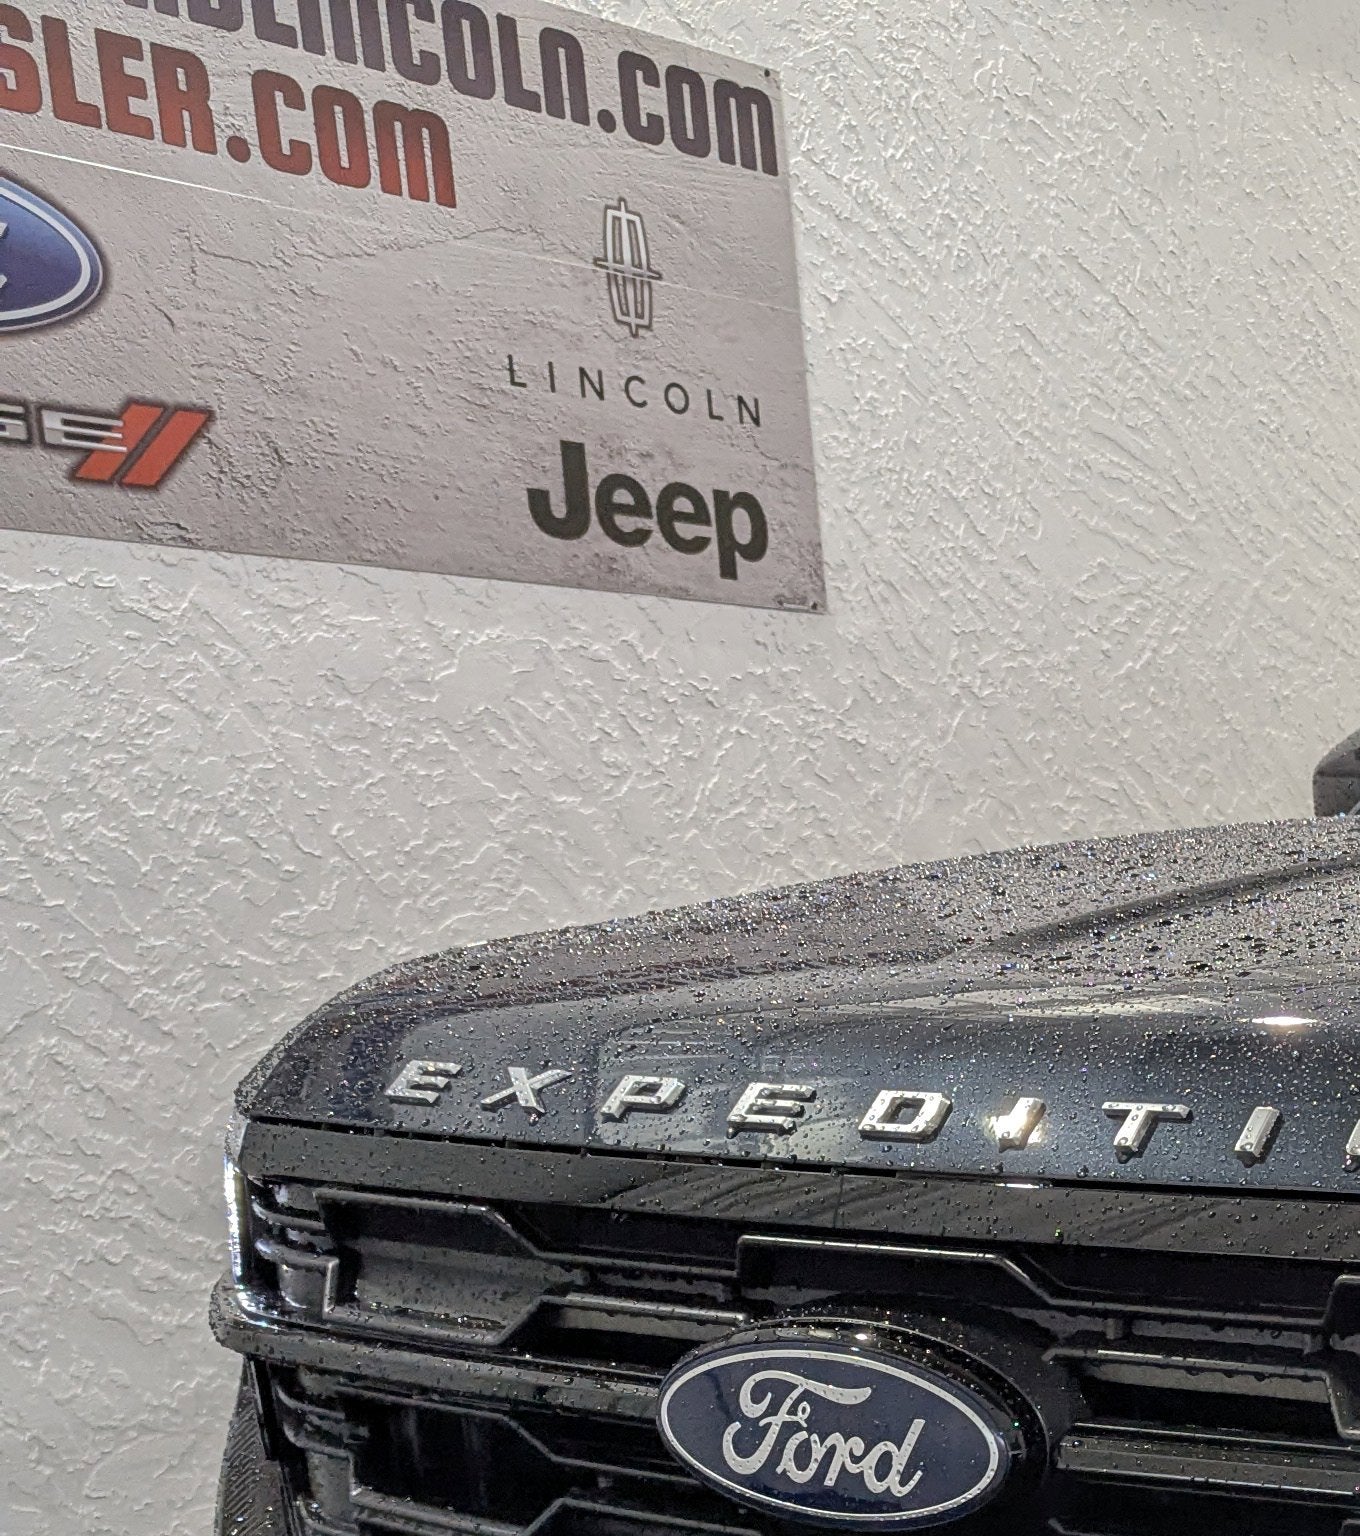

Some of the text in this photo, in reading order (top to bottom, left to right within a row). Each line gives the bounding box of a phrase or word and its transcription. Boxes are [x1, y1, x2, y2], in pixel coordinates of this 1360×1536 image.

[507, 353, 763, 429] LINCOLN
[526, 439, 769, 580] Jeep
[721, 1368, 926, 1498] Ford
